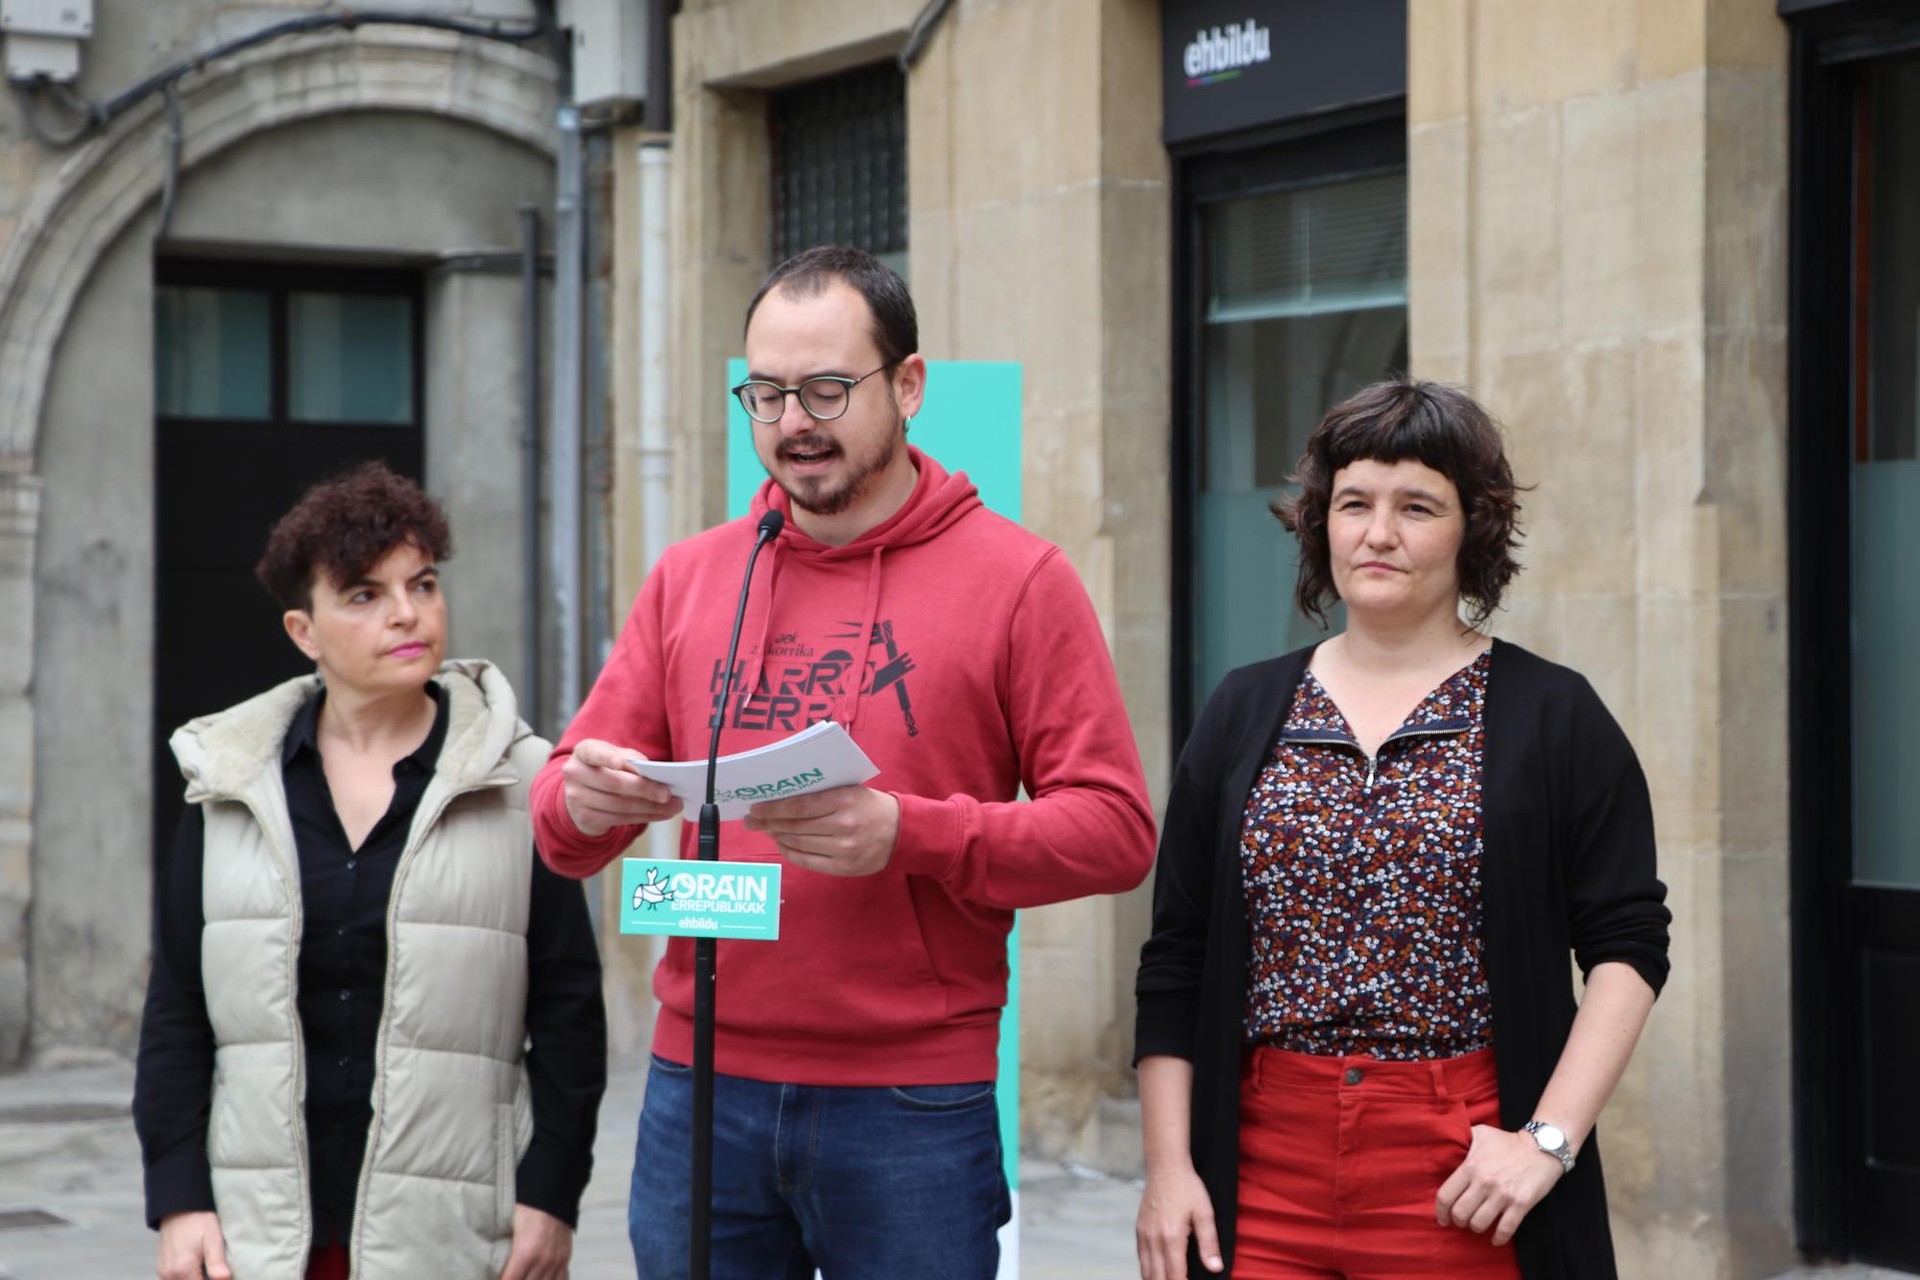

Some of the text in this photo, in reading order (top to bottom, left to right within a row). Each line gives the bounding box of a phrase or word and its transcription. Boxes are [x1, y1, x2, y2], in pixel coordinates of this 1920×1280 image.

[1184, 18, 1271, 77] ehbildu
[768, 644, 814, 657] korrika
[735, 767, 823, 798] ORAIN
[671, 872, 768, 902] ORAIN
[671, 899, 766, 914] ERREPUBLIKAK
[678, 916, 718, 930] ehbildu
